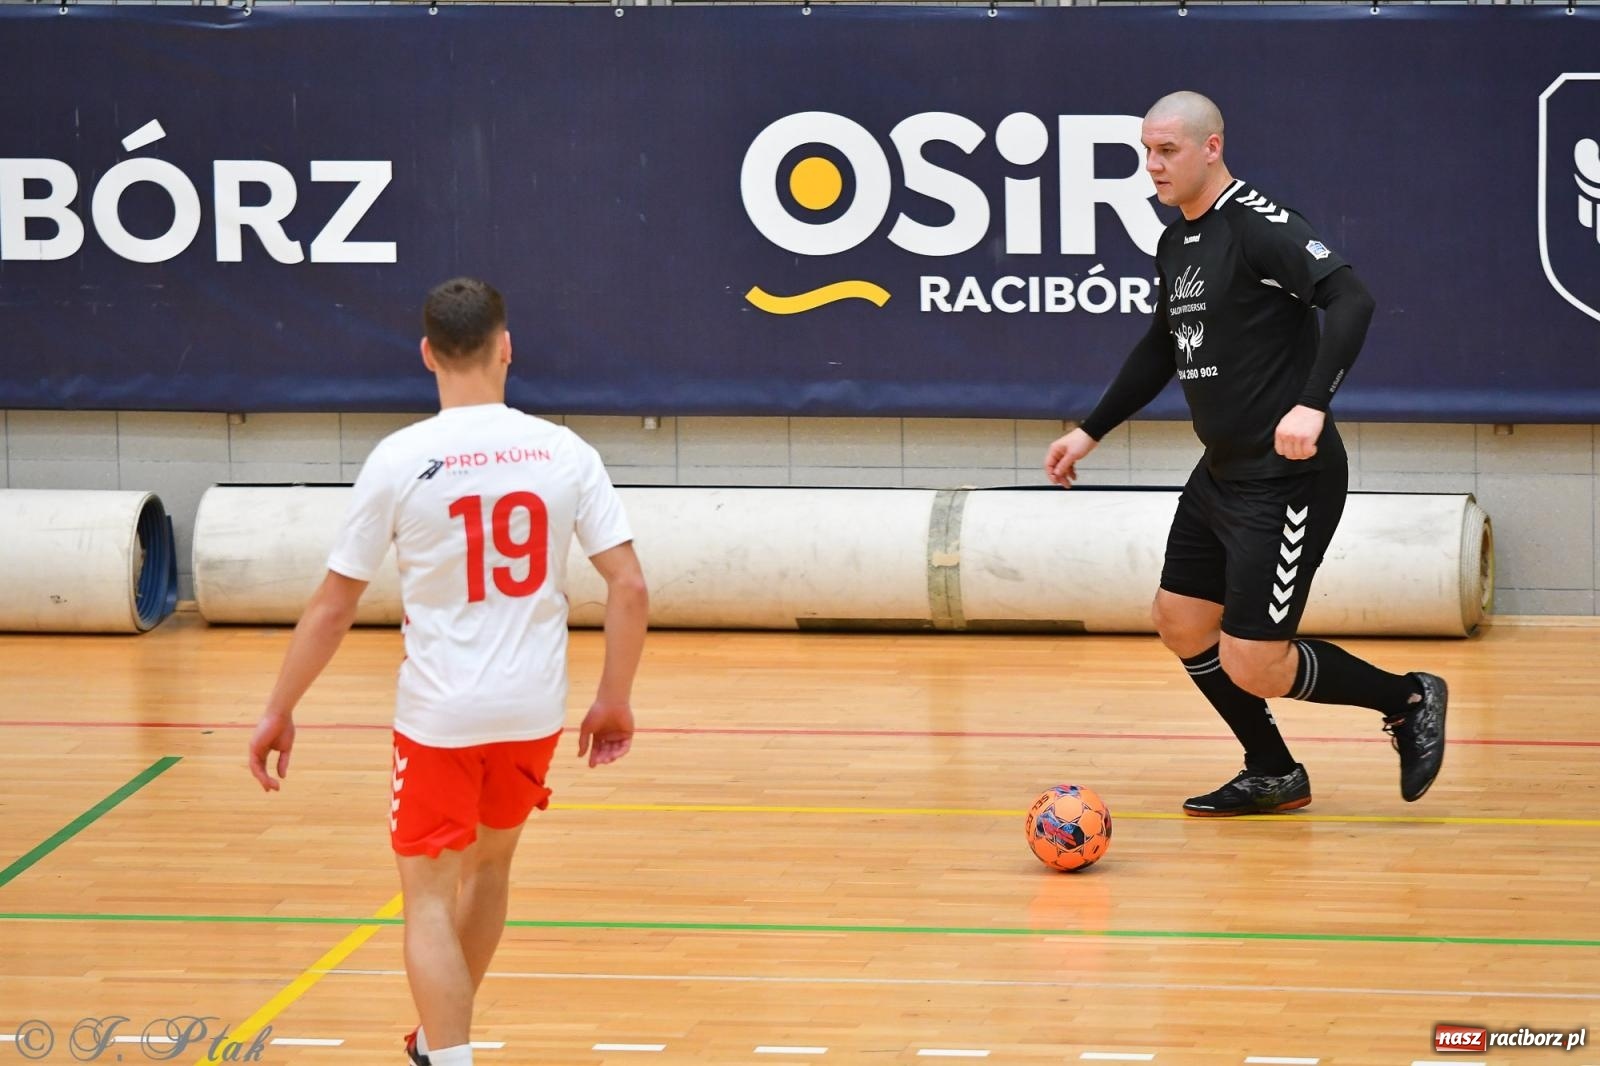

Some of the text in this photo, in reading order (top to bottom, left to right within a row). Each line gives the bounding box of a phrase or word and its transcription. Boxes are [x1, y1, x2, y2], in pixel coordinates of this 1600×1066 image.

[0, 118, 397, 264] BÓRZ
[1186, 369, 1199, 380] 260
[1200, 366, 1218, 378] 902
[445, 446, 551, 469] PRD KÜHN
[449, 491, 548, 603] 19
